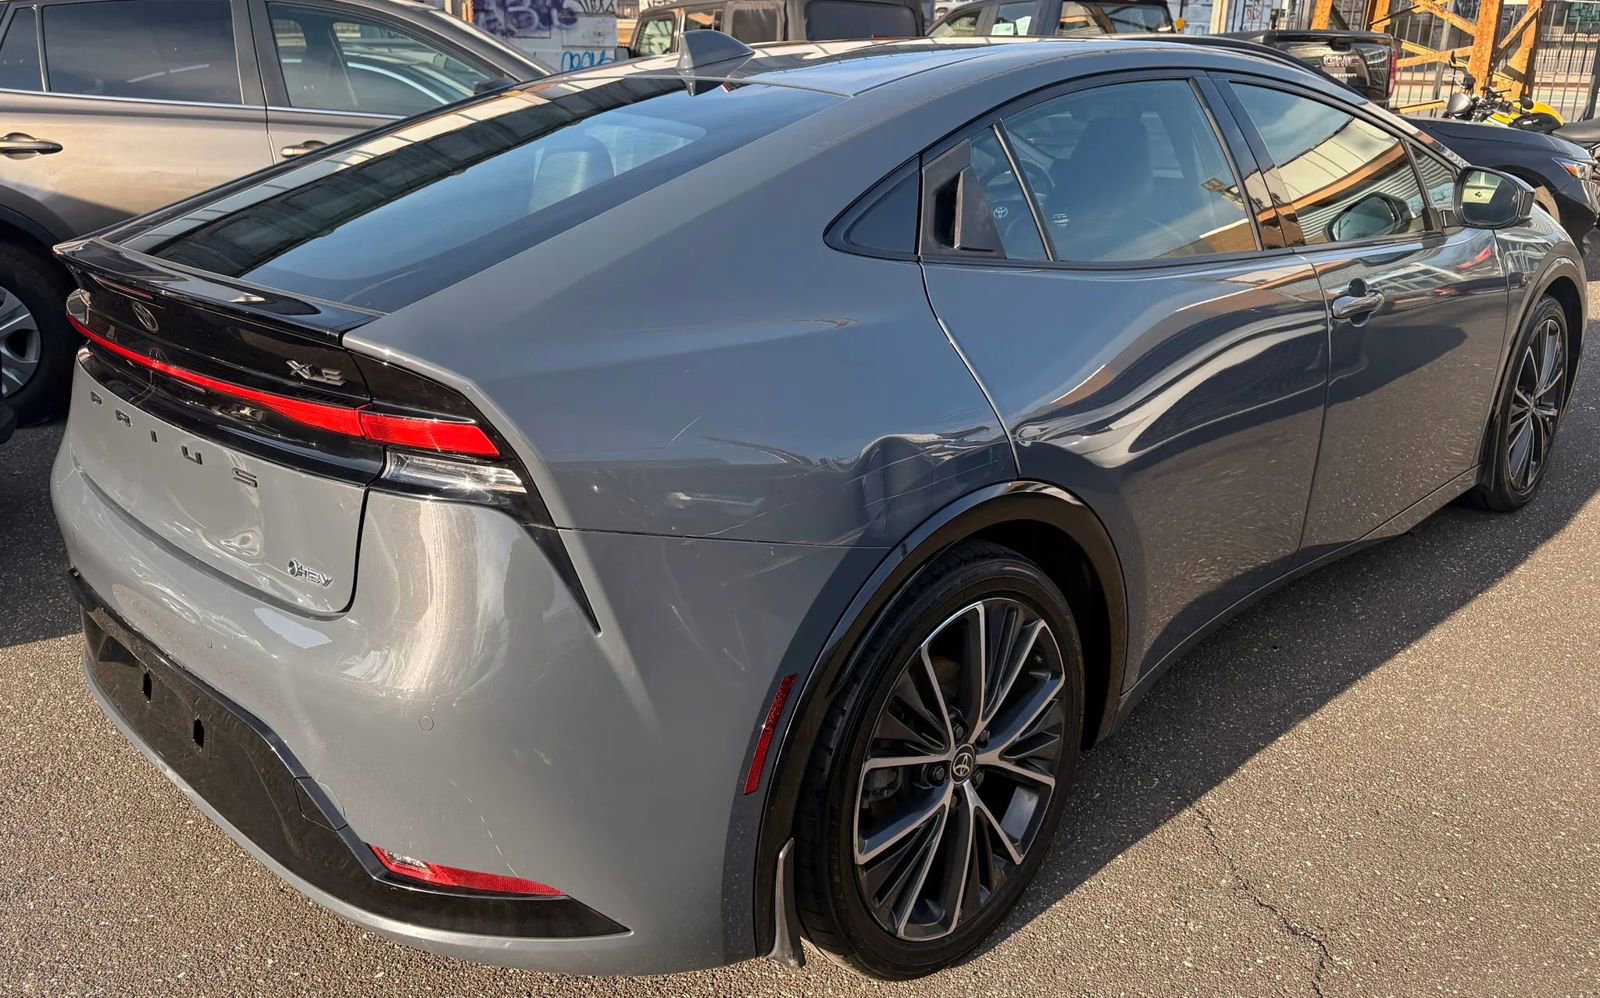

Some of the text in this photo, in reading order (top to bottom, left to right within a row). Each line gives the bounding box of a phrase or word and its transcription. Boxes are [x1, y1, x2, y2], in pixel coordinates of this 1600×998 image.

[1323, 54, 1360, 67] GMC
[286, 360, 345, 386] XLE
[90, 390, 258, 488] PRIUS
[298, 564, 334, 587] HEV
